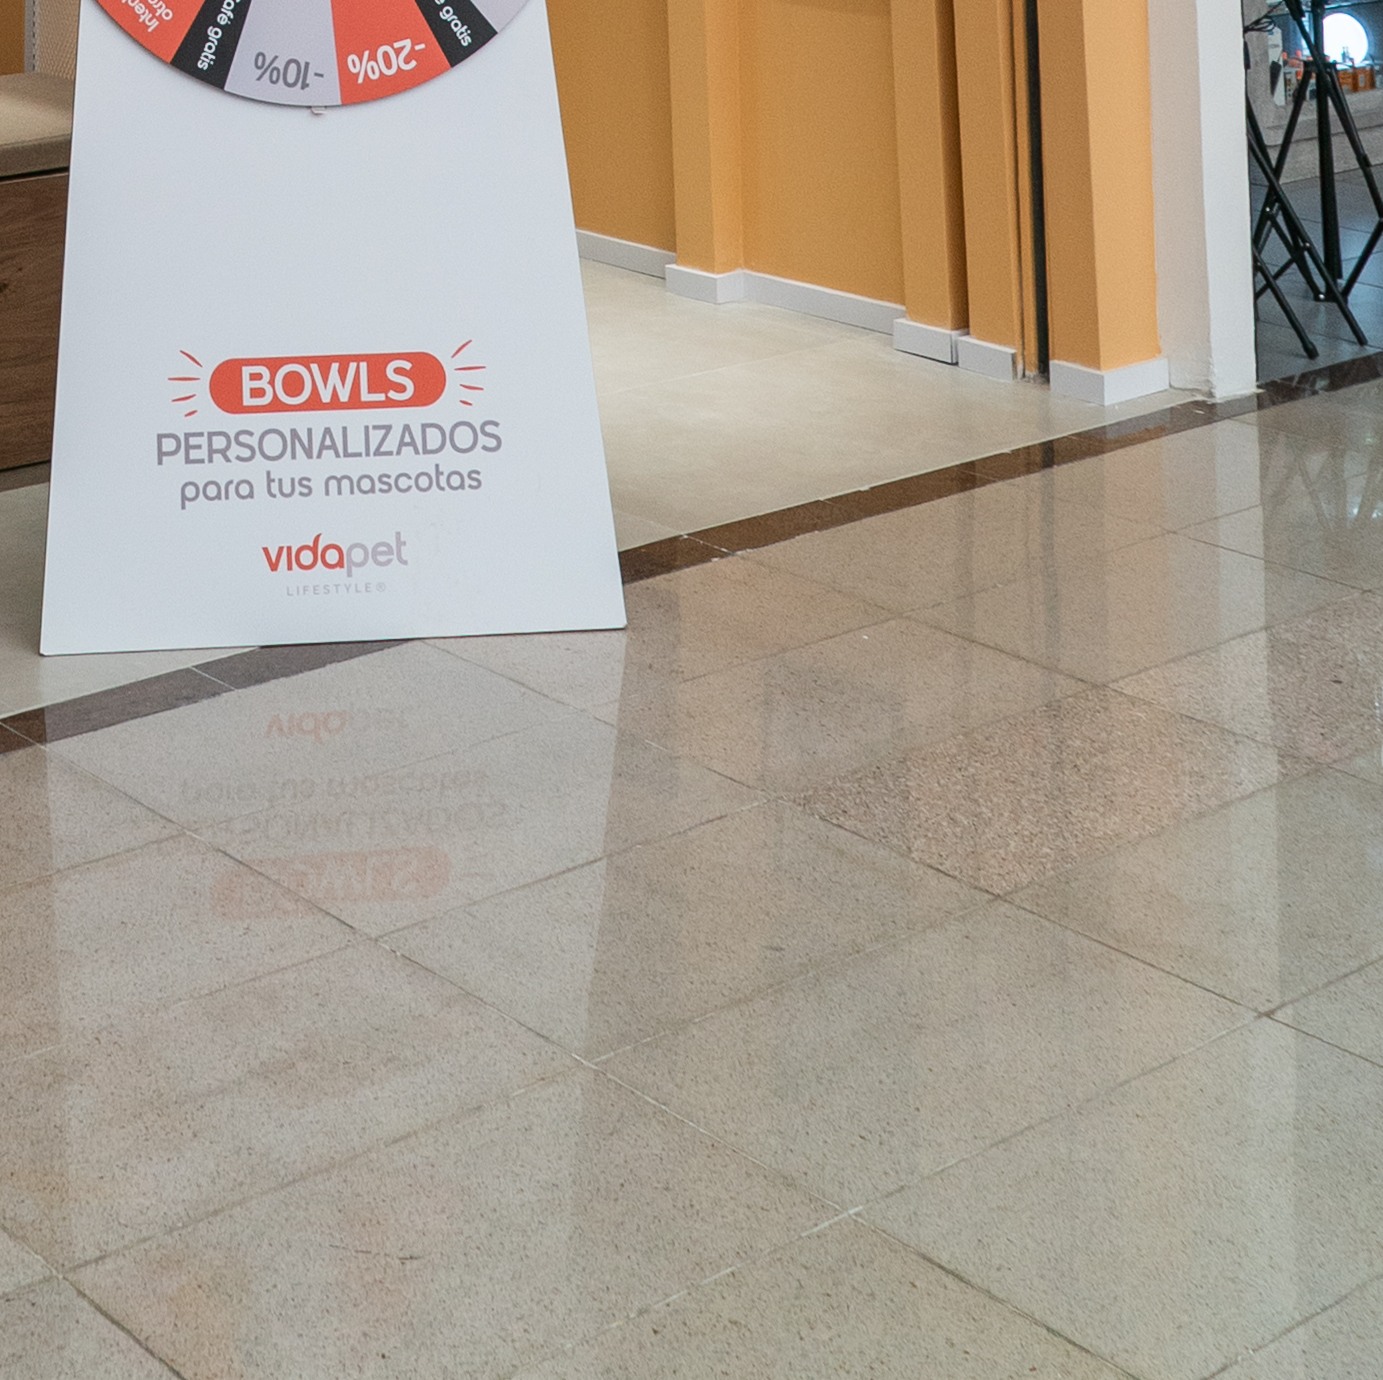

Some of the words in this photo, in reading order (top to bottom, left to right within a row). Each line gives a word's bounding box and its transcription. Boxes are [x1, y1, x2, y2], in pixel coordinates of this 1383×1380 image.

[197, 26, 222, 71] gratis
[439, 6, 472, 46] gratis
[254, 52, 324, 90] -10%
[347, 38, 425, 84] -20%
[241, 359, 415, 407] BOWLS
[157, 420, 502, 466] PERSONALIZADOS
[180, 477, 254, 510] para
[266, 470, 312, 498] tus
[324, 464, 482, 496] mascotas
[262, 531, 408, 578] vidapet
